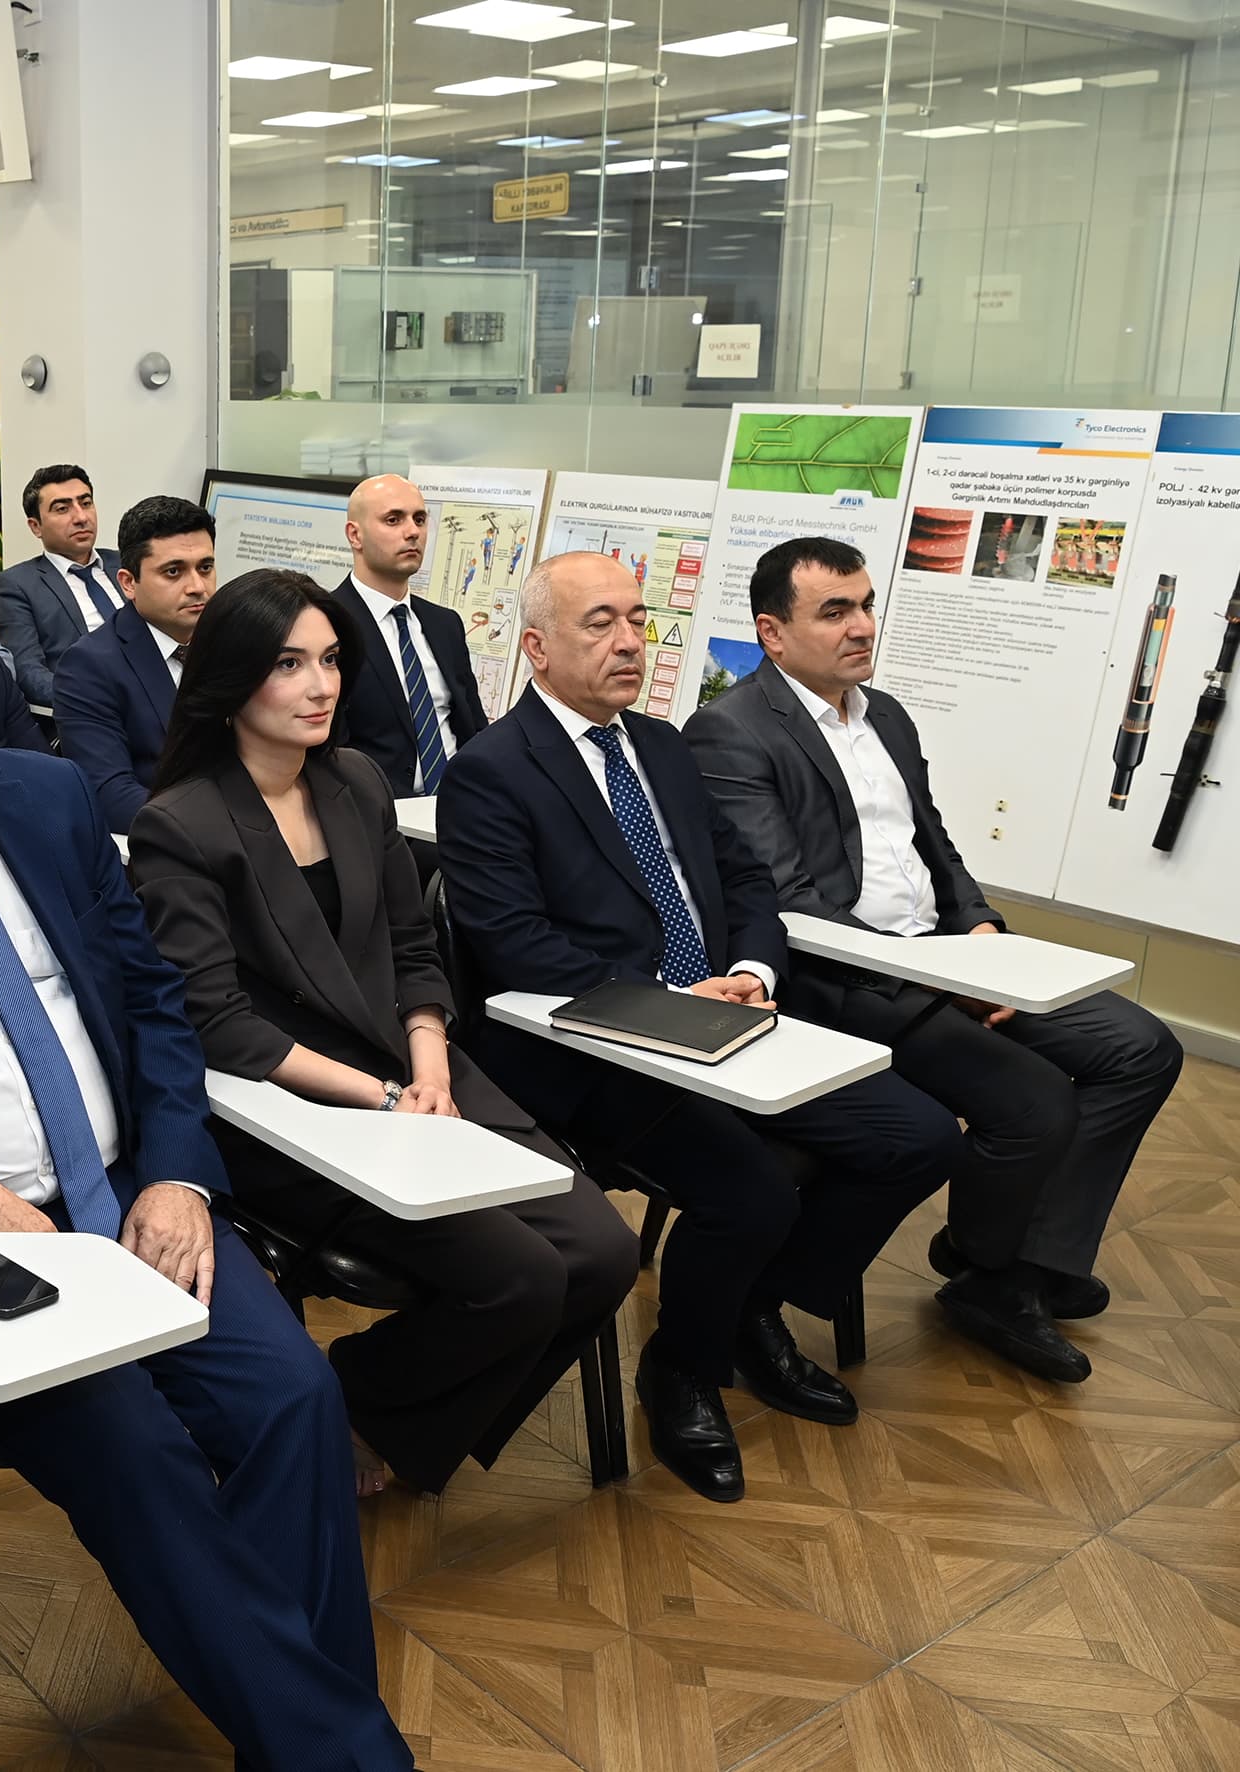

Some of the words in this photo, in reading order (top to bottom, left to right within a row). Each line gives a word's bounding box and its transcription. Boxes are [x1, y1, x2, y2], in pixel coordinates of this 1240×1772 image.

[1086, 424, 1102, 433] Tyco
[1104, 425, 1146, 433] Electronics
[927, 468, 940, 477] 1-ci,
[943, 469, 956, 477] 2-ci
[990, 472, 1024, 482] boşalma
[1064, 475, 1074, 483] 35
[1003, 484, 1023, 493] üçün
[1025, 487, 1056, 495] polimer
[1057, 488, 1097, 498] korpusda
[1159, 482, 1184, 492] POLJ
[1198, 485, 1209, 493] 42
[731, 513, 756, 523] BAUR
[758, 515, 777, 525] Prüf-
[778, 518, 793, 526] und
[795, 519, 847, 530] Messtechnik
[849, 522, 877, 533] GmbH
